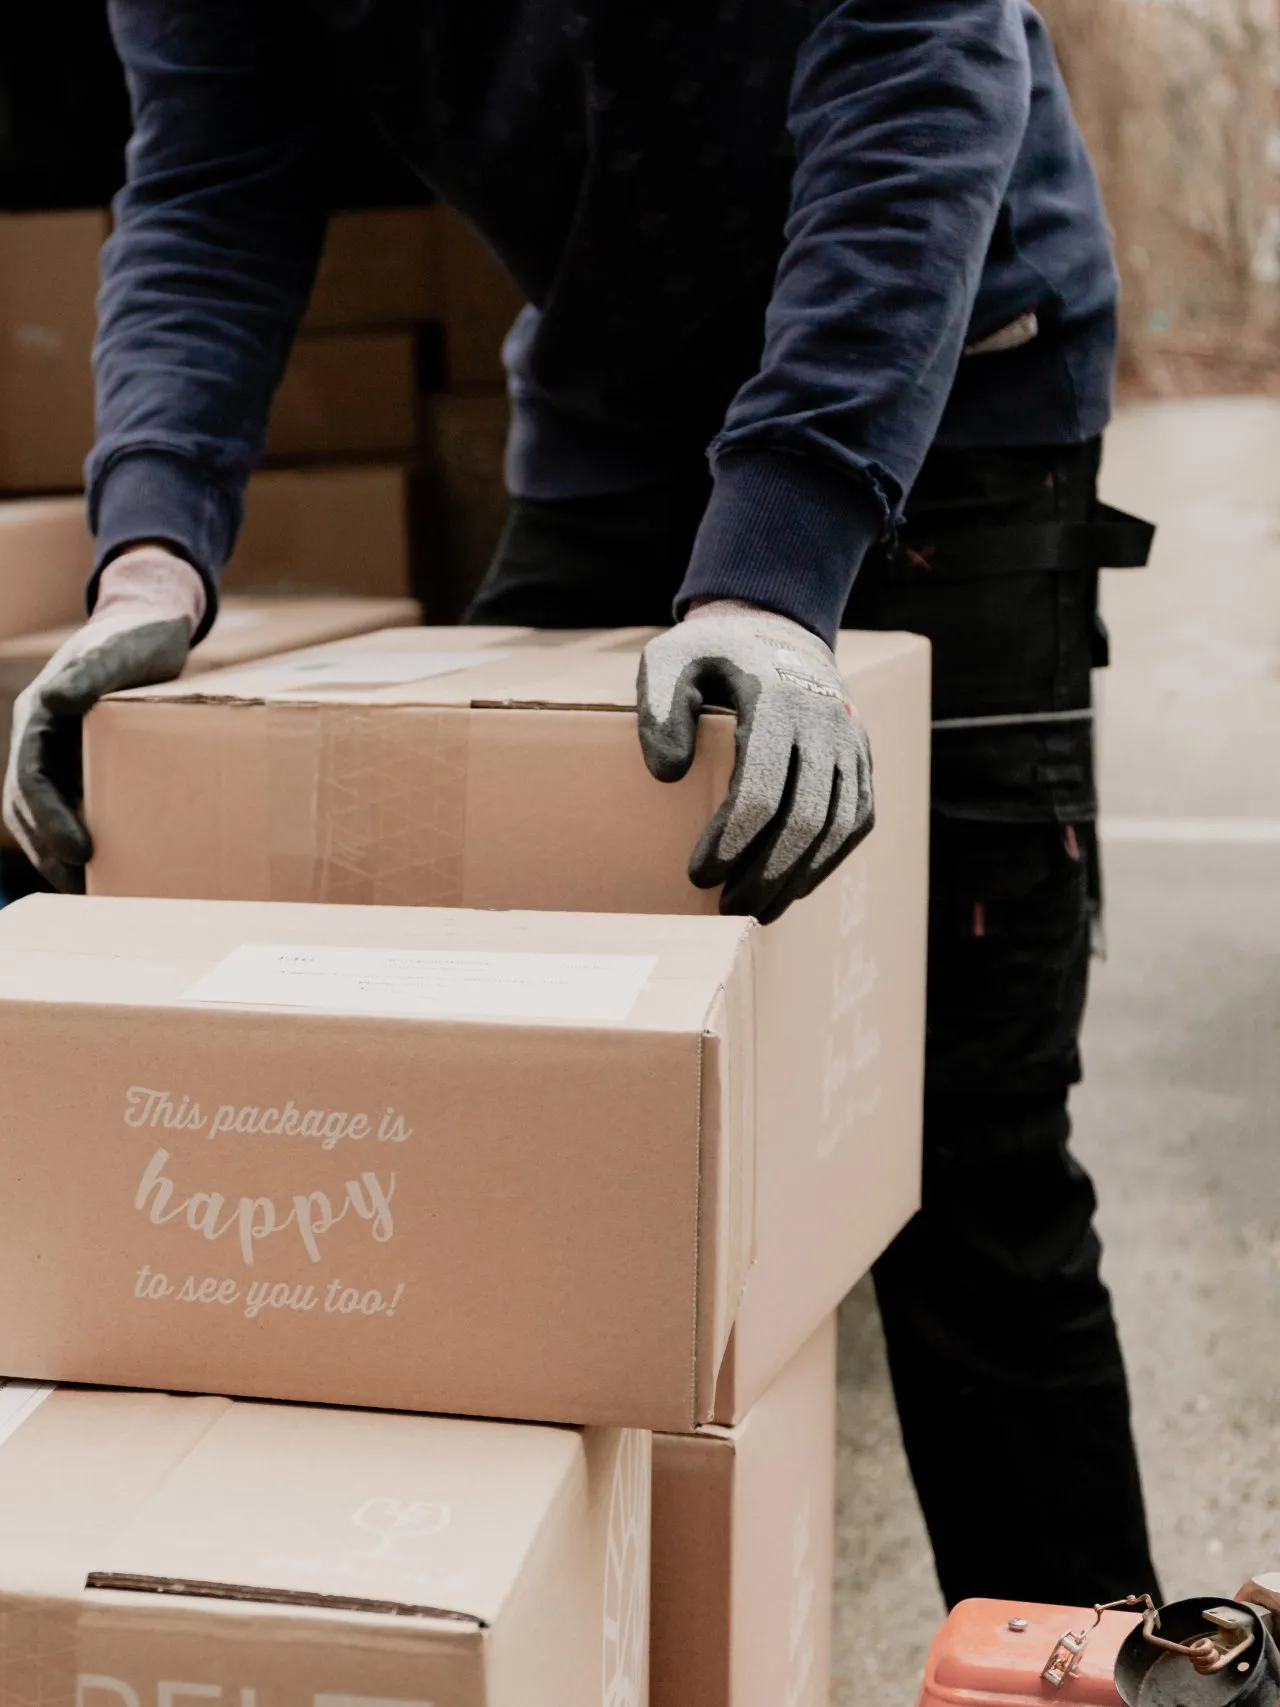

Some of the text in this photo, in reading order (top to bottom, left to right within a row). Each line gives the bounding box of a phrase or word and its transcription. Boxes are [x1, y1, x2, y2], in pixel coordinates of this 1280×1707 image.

[124, 1086, 413, 1150] This package is
[134, 1147, 396, 1267] happy
[133, 1264, 405, 1319] to see you too!
